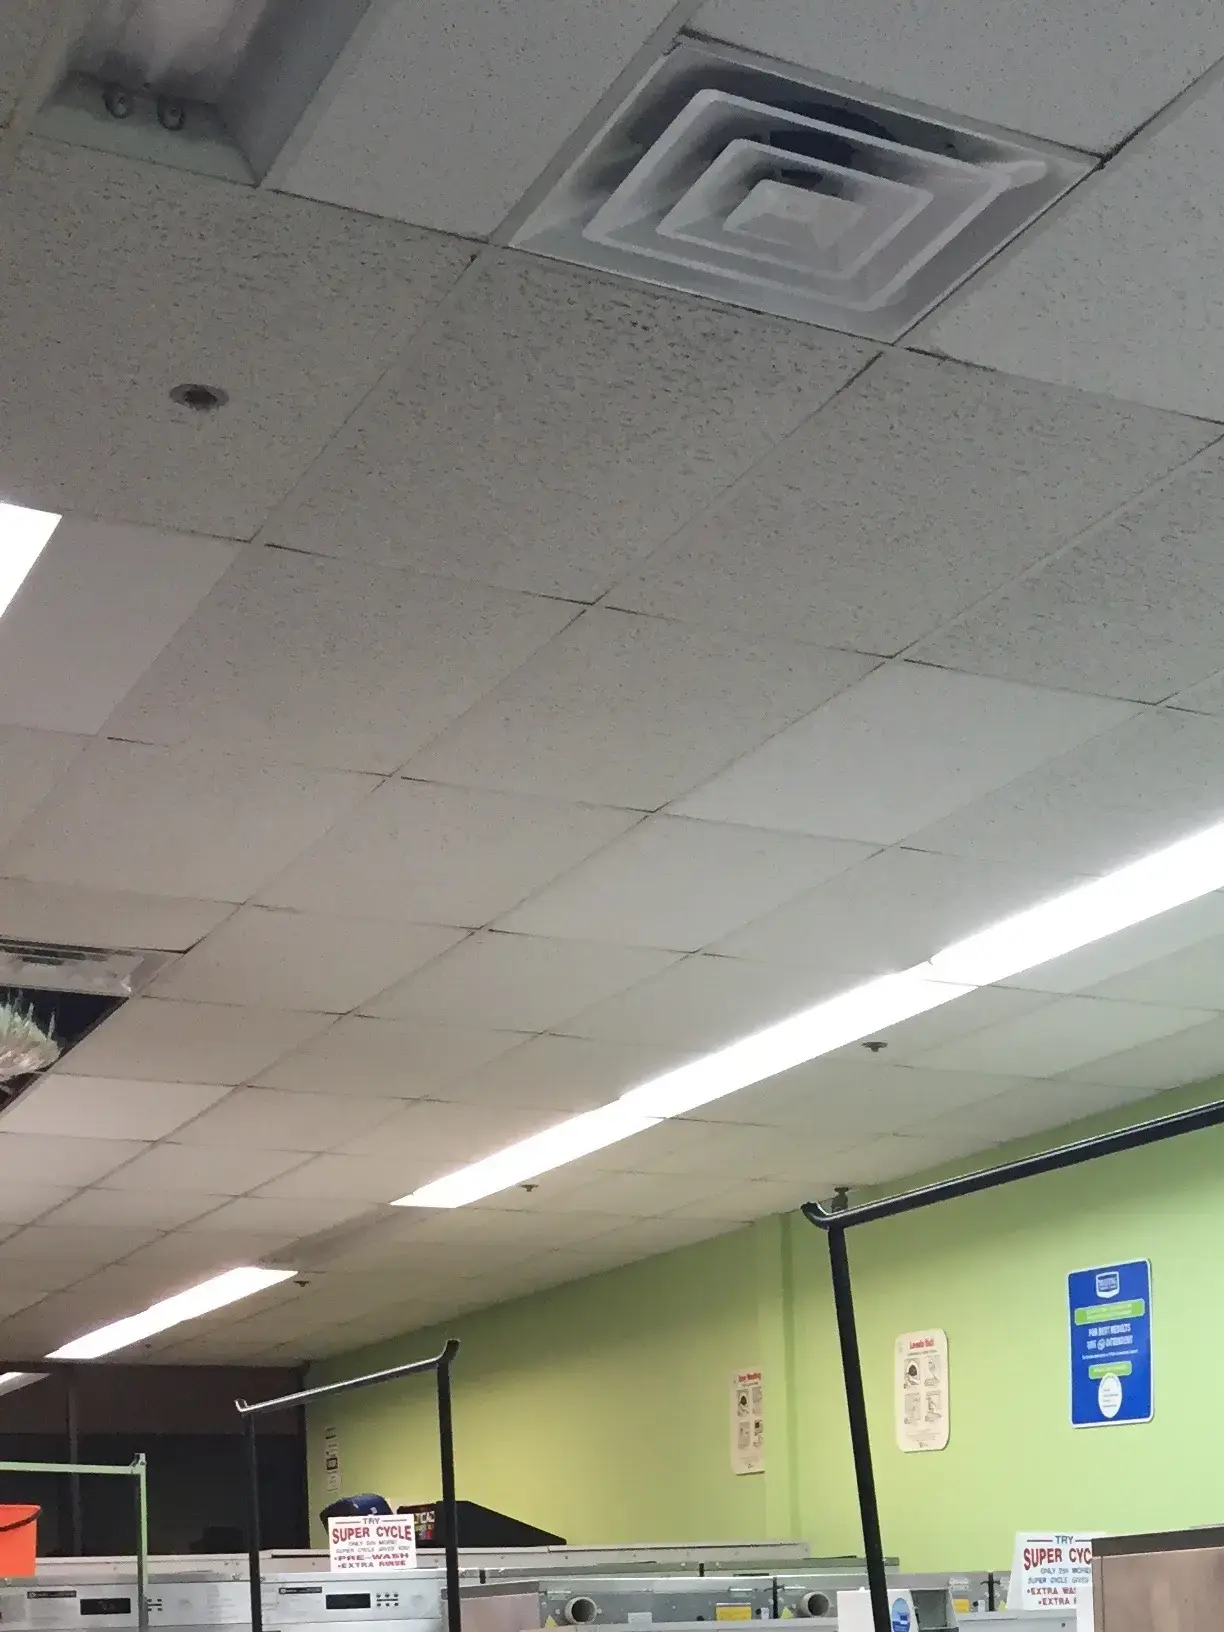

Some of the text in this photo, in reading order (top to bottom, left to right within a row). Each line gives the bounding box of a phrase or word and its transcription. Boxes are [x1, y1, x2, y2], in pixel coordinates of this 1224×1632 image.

[363, 1517, 380, 1525] TRY
[332, 1525, 412, 1544] SUPER CYCLE
[1055, 1535, 1074, 1544] TRY
[1023, 1547, 1092, 1570] SUPER CYC
[1030, 1587, 1076, 1595] EXTRA WA
[1042, 1597, 1070, 1605] EXTRA
